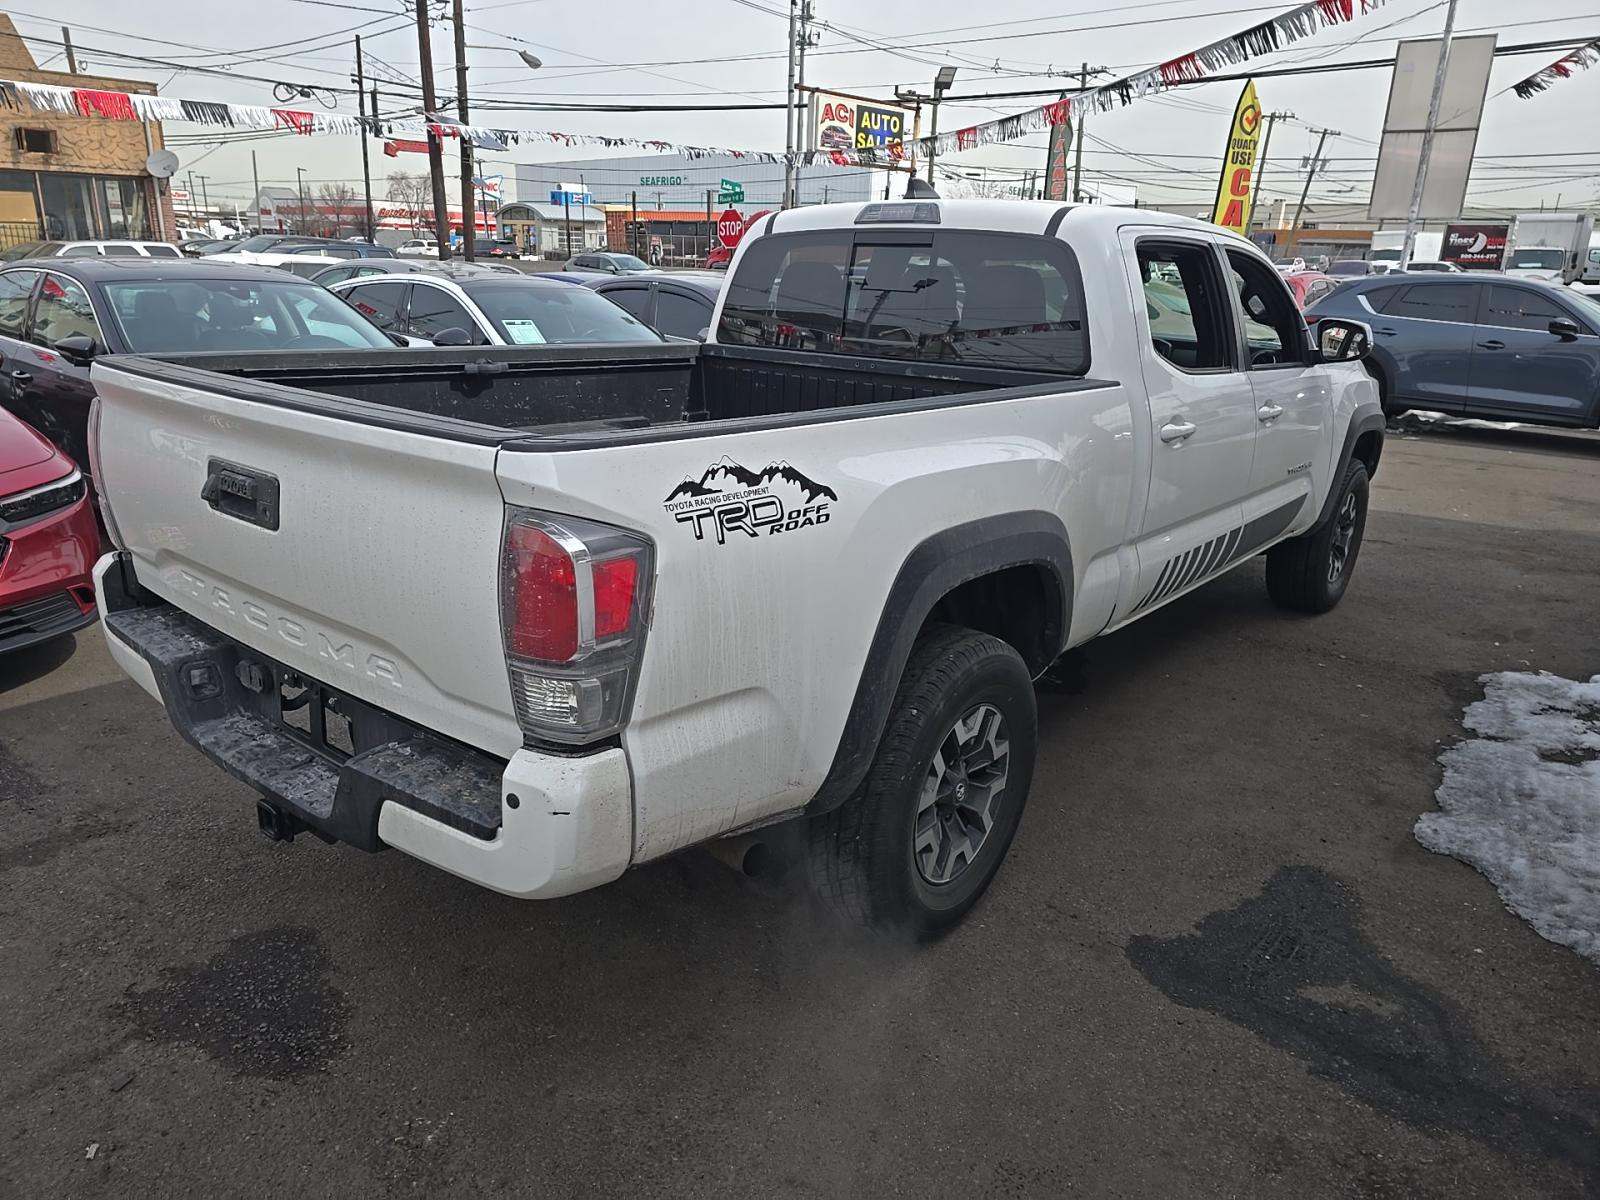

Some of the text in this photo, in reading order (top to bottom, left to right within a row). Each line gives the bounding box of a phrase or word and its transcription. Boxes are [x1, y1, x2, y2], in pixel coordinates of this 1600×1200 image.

[820, 103, 855, 128] ACI
[861, 111, 900, 133] AUTO
[640, 176, 682, 186] SEAFRIGO
[720, 222, 742, 236] STOP
[664, 487, 769, 512] TOYOTA RACING DEVELOPMENT
[675, 495, 784, 545] TRD
[787, 503, 829, 521] OFF
[769, 513, 831, 535] ROAD
[180, 569, 403, 688] TACOMA
